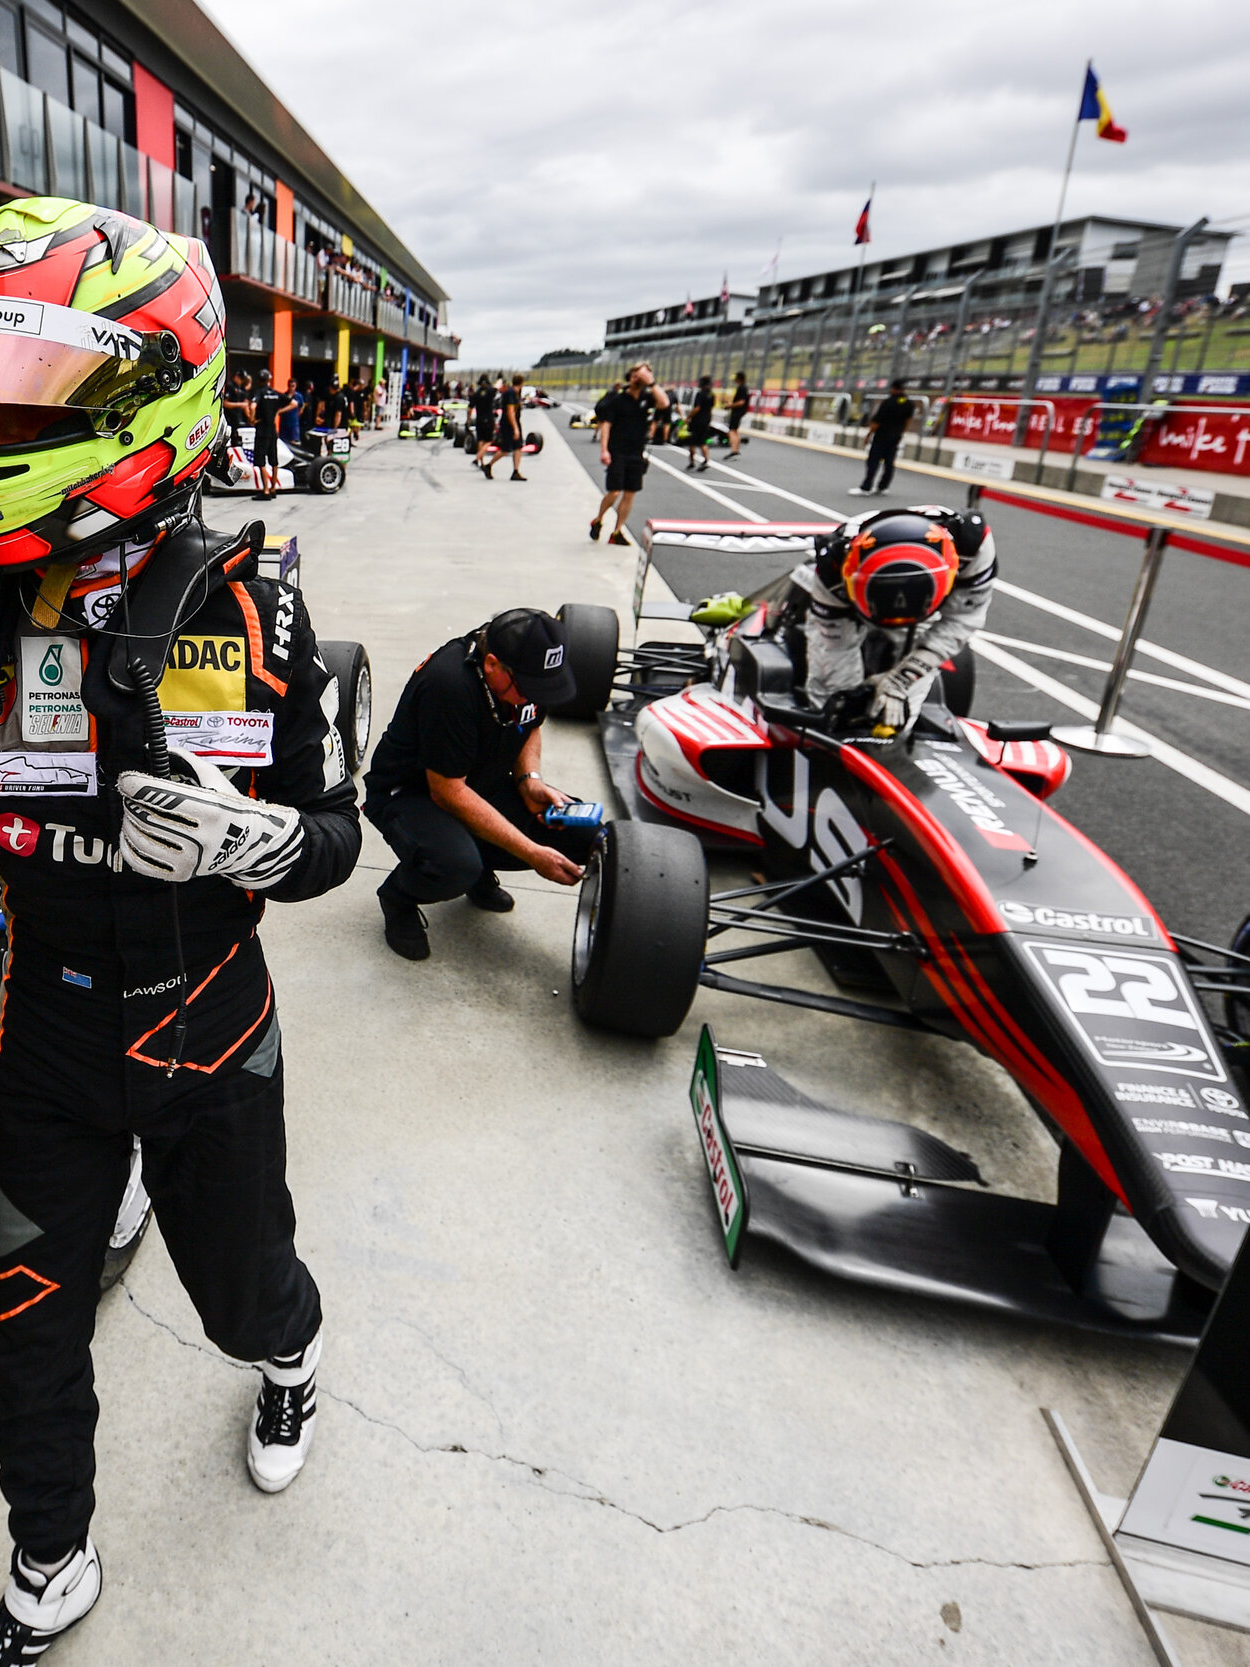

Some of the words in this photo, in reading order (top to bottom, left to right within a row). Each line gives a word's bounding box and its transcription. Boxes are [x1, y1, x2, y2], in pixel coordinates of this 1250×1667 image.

[189, 420, 209, 445] BELL
[271, 584, 294, 662] HRX
[28, 691, 81, 700] PETRONAS
[28, 703, 82, 713] PETRONAS
[28, 714, 82, 736] SELENIA
[170, 716, 199, 727] Castrol
[226, 716, 270, 728] TOYOTA
[4, 784, 27, 792] DRIVER
[208, 824, 251, 872] adidas
[1035, 907, 1149, 937] Castrol
[123, 973, 188, 999] LAWSON
[1041, 948, 1199, 1031] 22
[1114, 1090, 1197, 1108] INSURANCE
[1117, 1082, 1177, 1097] FINANCE
[701, 1104, 734, 1214] Castrol
[1161, 1152, 1214, 1170] POST
